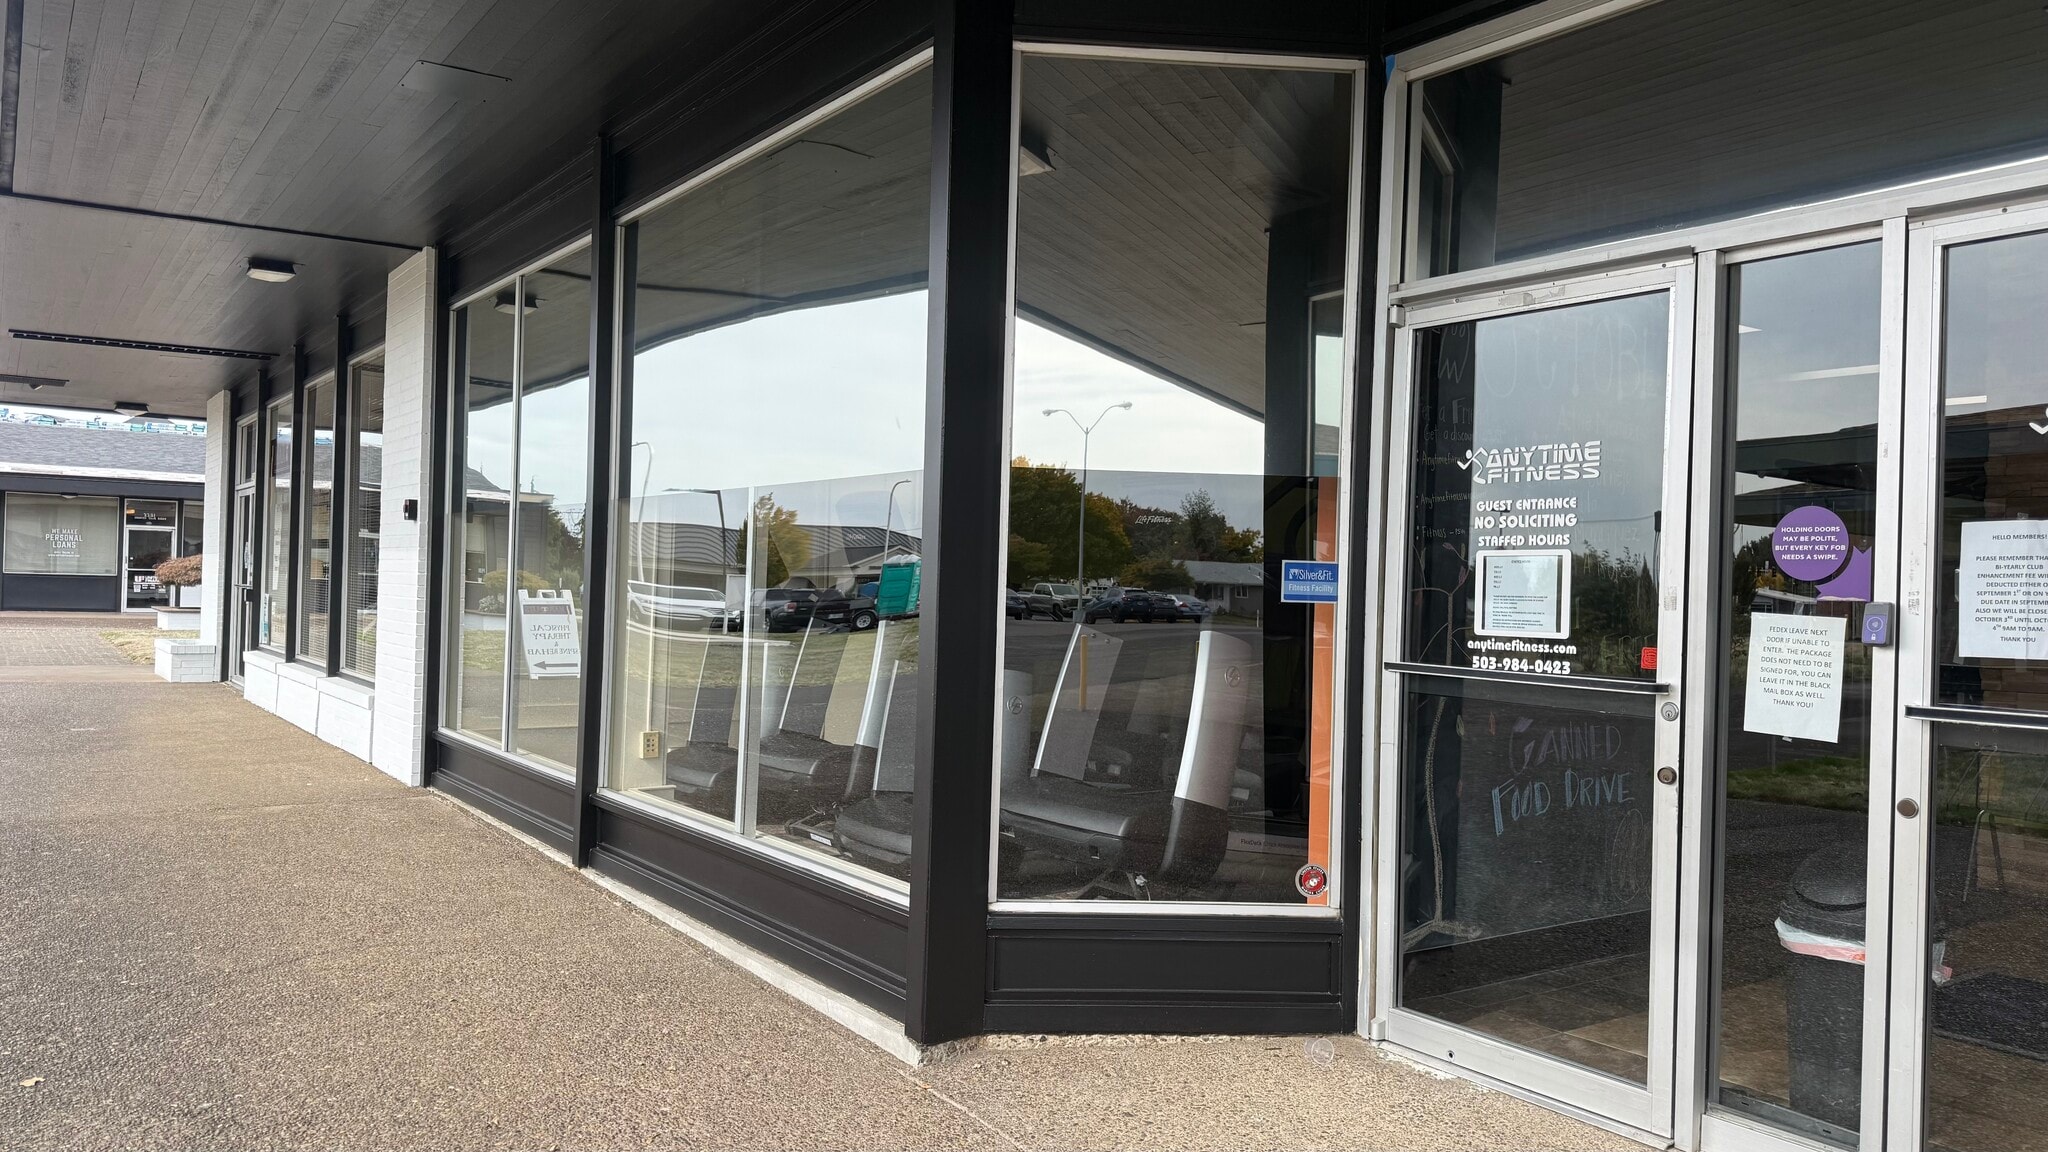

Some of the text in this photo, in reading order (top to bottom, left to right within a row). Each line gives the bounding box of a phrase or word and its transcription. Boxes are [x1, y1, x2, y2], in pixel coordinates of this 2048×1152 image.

[1486, 441, 1601, 467] ANYTIME
[1488, 462, 1600, 484] FITNESS
[1477, 497, 1577, 511] GUEST ENTRANCE
[1475, 514, 1577, 529] NO SOLICITING
[45, 533, 84, 542] PERSONAL
[1478, 534, 1570, 546] STAFFED HOURS
[1288, 584, 1334, 594] Fitness Facility
[1467, 638, 1576, 654] anytimefitness.com
[1472, 656, 1570, 674] 503-984-0423
[1492, 768, 1635, 837] FOOD DRIVE
